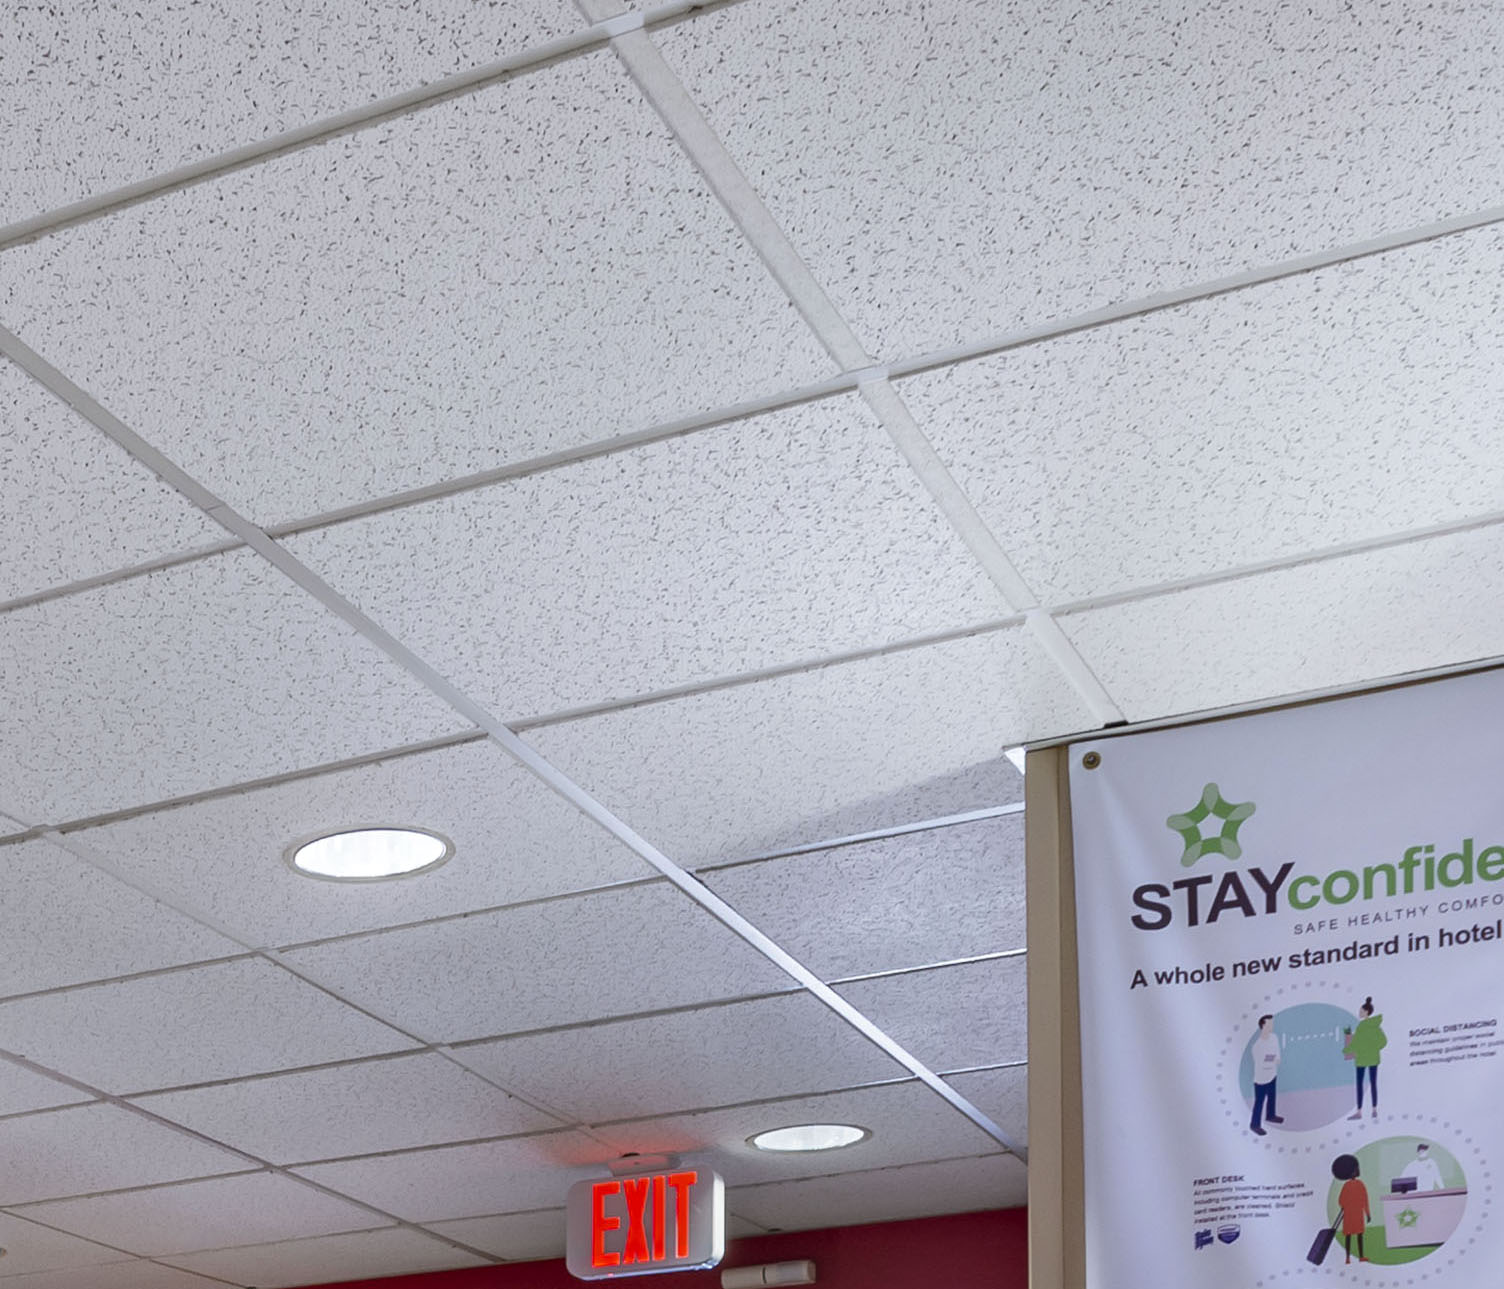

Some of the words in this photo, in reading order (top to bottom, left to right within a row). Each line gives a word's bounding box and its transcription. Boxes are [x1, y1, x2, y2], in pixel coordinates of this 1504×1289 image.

[1294, 918, 1340, 935] SAFE
[1347, 905, 1430, 927] HEALTHY
[1130, 969, 1148, 990] A
[1154, 963, 1225, 985] whole
[1232, 956, 1282, 977] new
[1288, 935, 1399, 969] standard
[1408, 932, 1430, 952] in
[1439, 919, 1502, 948] hotel
[1409, 1027, 1440, 1037] SOCIAL
[1443, 1019, 1497, 1033] DISTANCING
[1193, 1176, 1219, 1186] FRONT
[1221, 1175, 1245, 1184] DESK
[592, 1171, 698, 1268] EXIT
